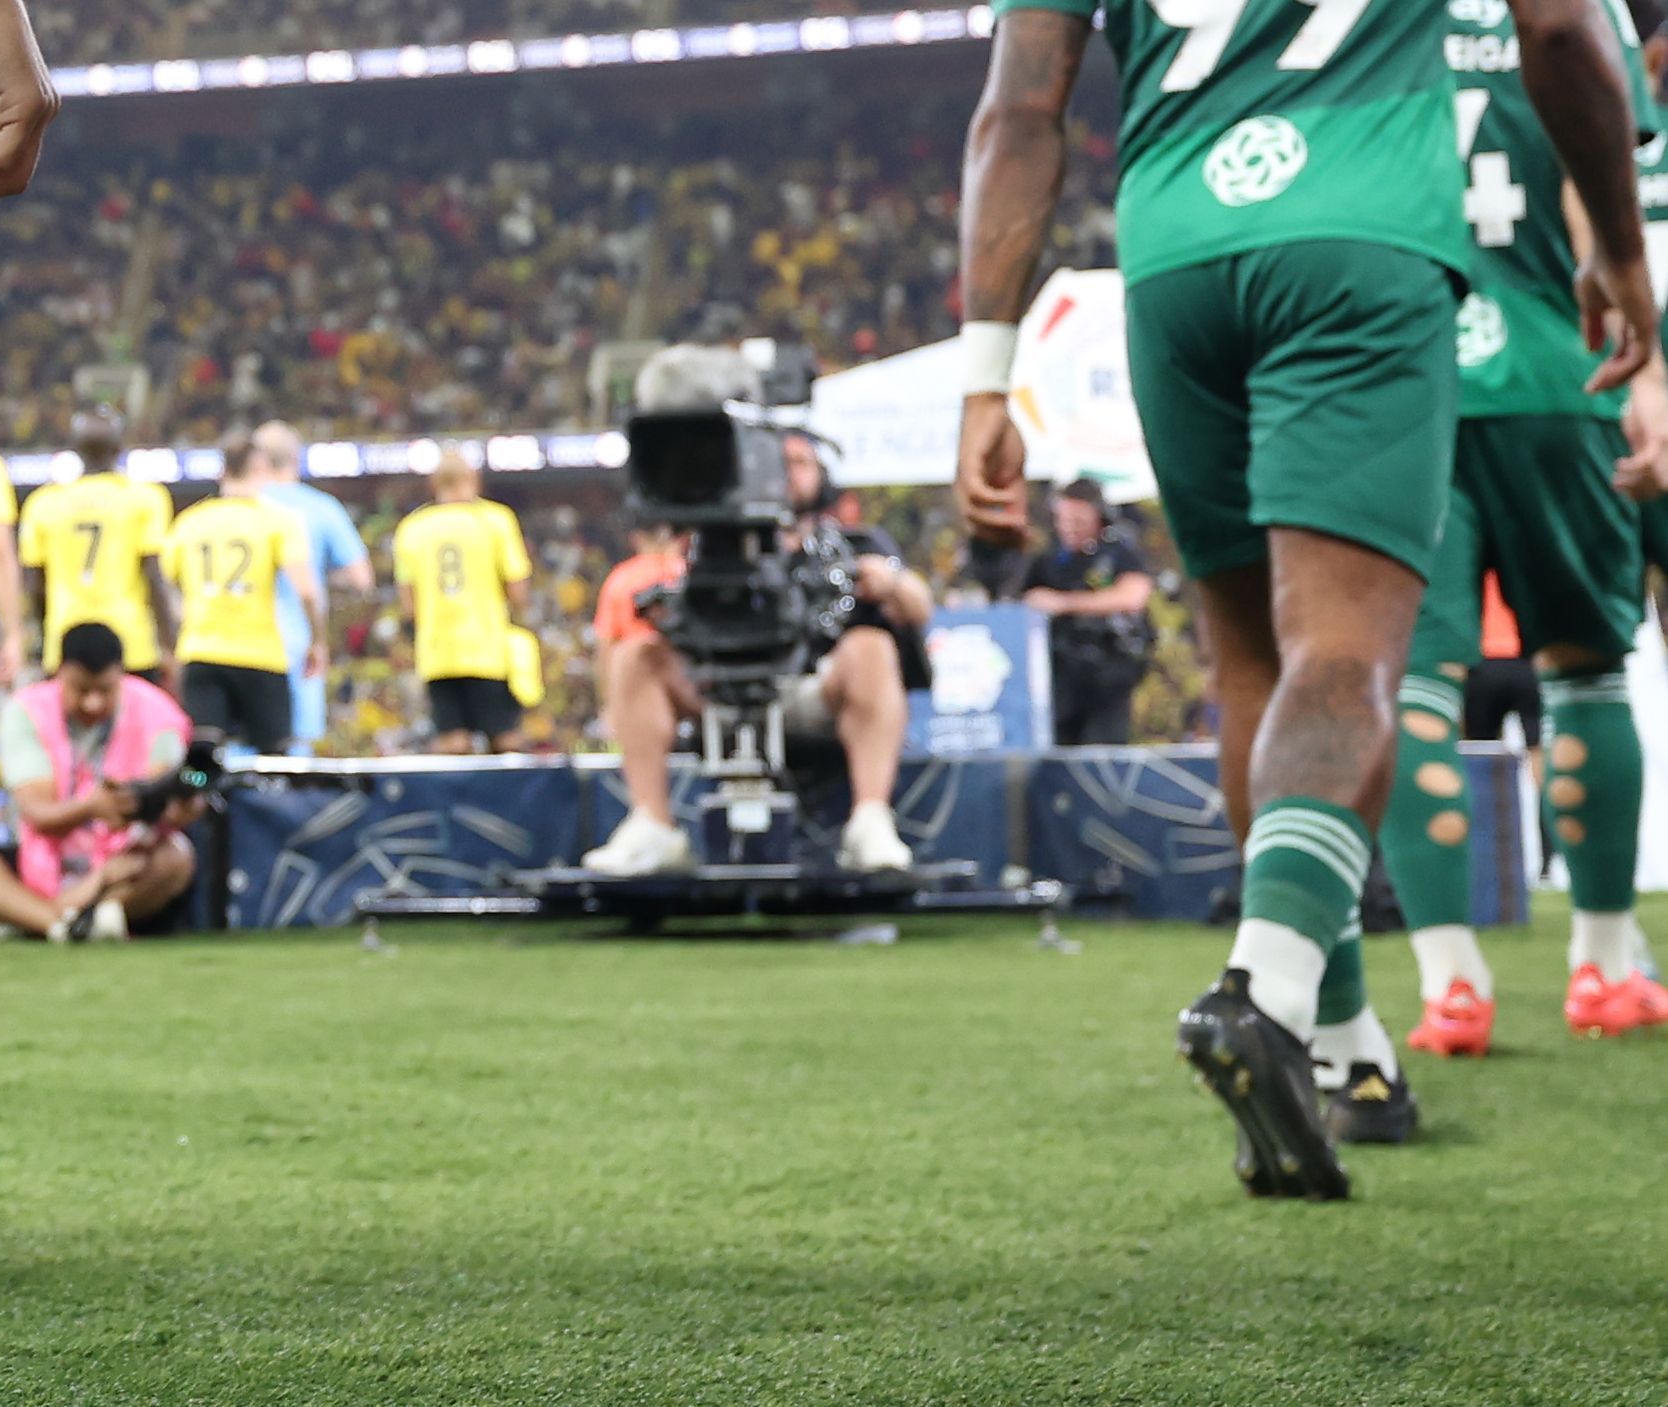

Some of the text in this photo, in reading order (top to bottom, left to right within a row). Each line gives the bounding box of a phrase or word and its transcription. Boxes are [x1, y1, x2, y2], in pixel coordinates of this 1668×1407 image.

[1443, 31, 1522, 73] EIGA
[1454, 88, 1527, 248] 4
[72, 521, 103, 585] 7
[197, 538, 255, 591] 12
[435, 543, 465, 595] 8
